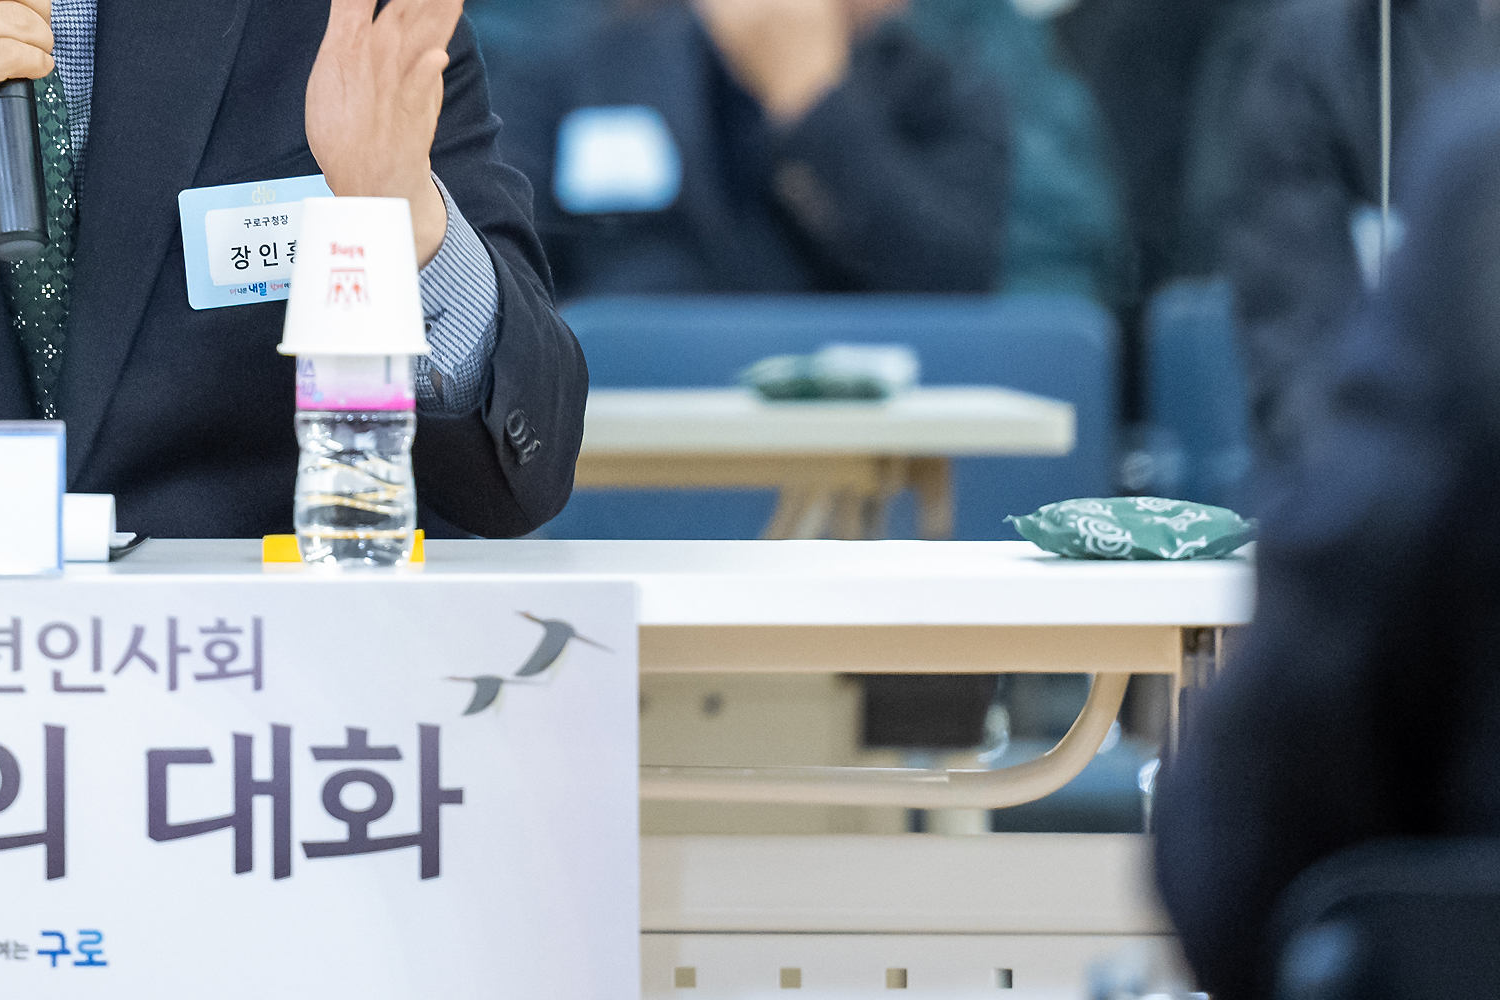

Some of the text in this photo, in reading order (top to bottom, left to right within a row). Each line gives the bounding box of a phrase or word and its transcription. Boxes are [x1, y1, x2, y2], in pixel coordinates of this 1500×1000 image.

[243, 214, 289, 229] 구로구청장
[248, 281, 267, 296] 내일
[146, 722, 465, 882] 대화
[36, 929, 109, 968] 구로
